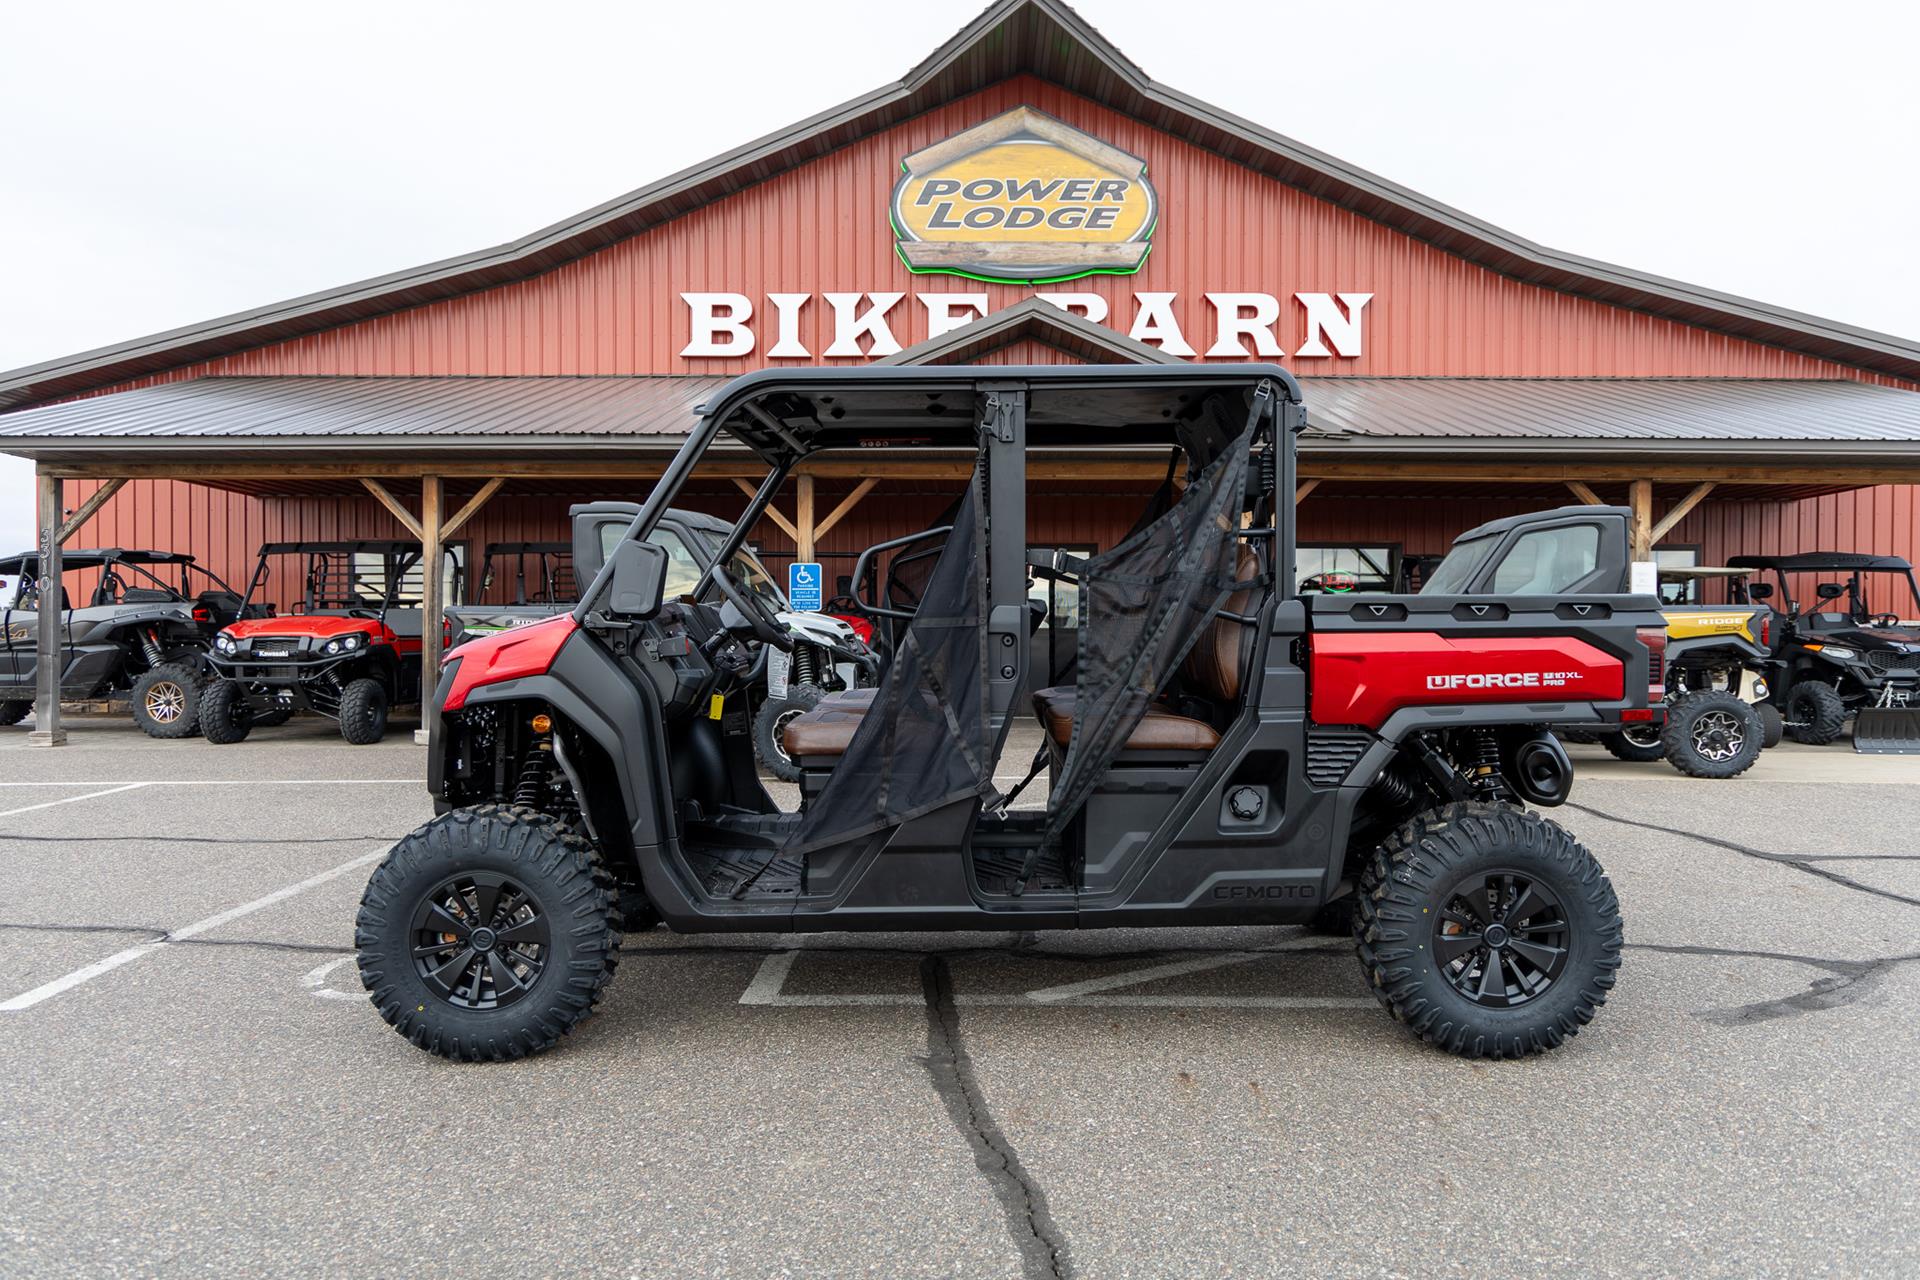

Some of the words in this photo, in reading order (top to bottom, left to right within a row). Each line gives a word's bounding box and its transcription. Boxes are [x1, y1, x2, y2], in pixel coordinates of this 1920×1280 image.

[915, 179, 1129, 205] POWER
[926, 202, 1120, 229] LODGE
[40, 528, 50, 592] 3310
[1427, 672, 1540, 689] UFORCE
[1214, 885, 1316, 899] CFMOTO
